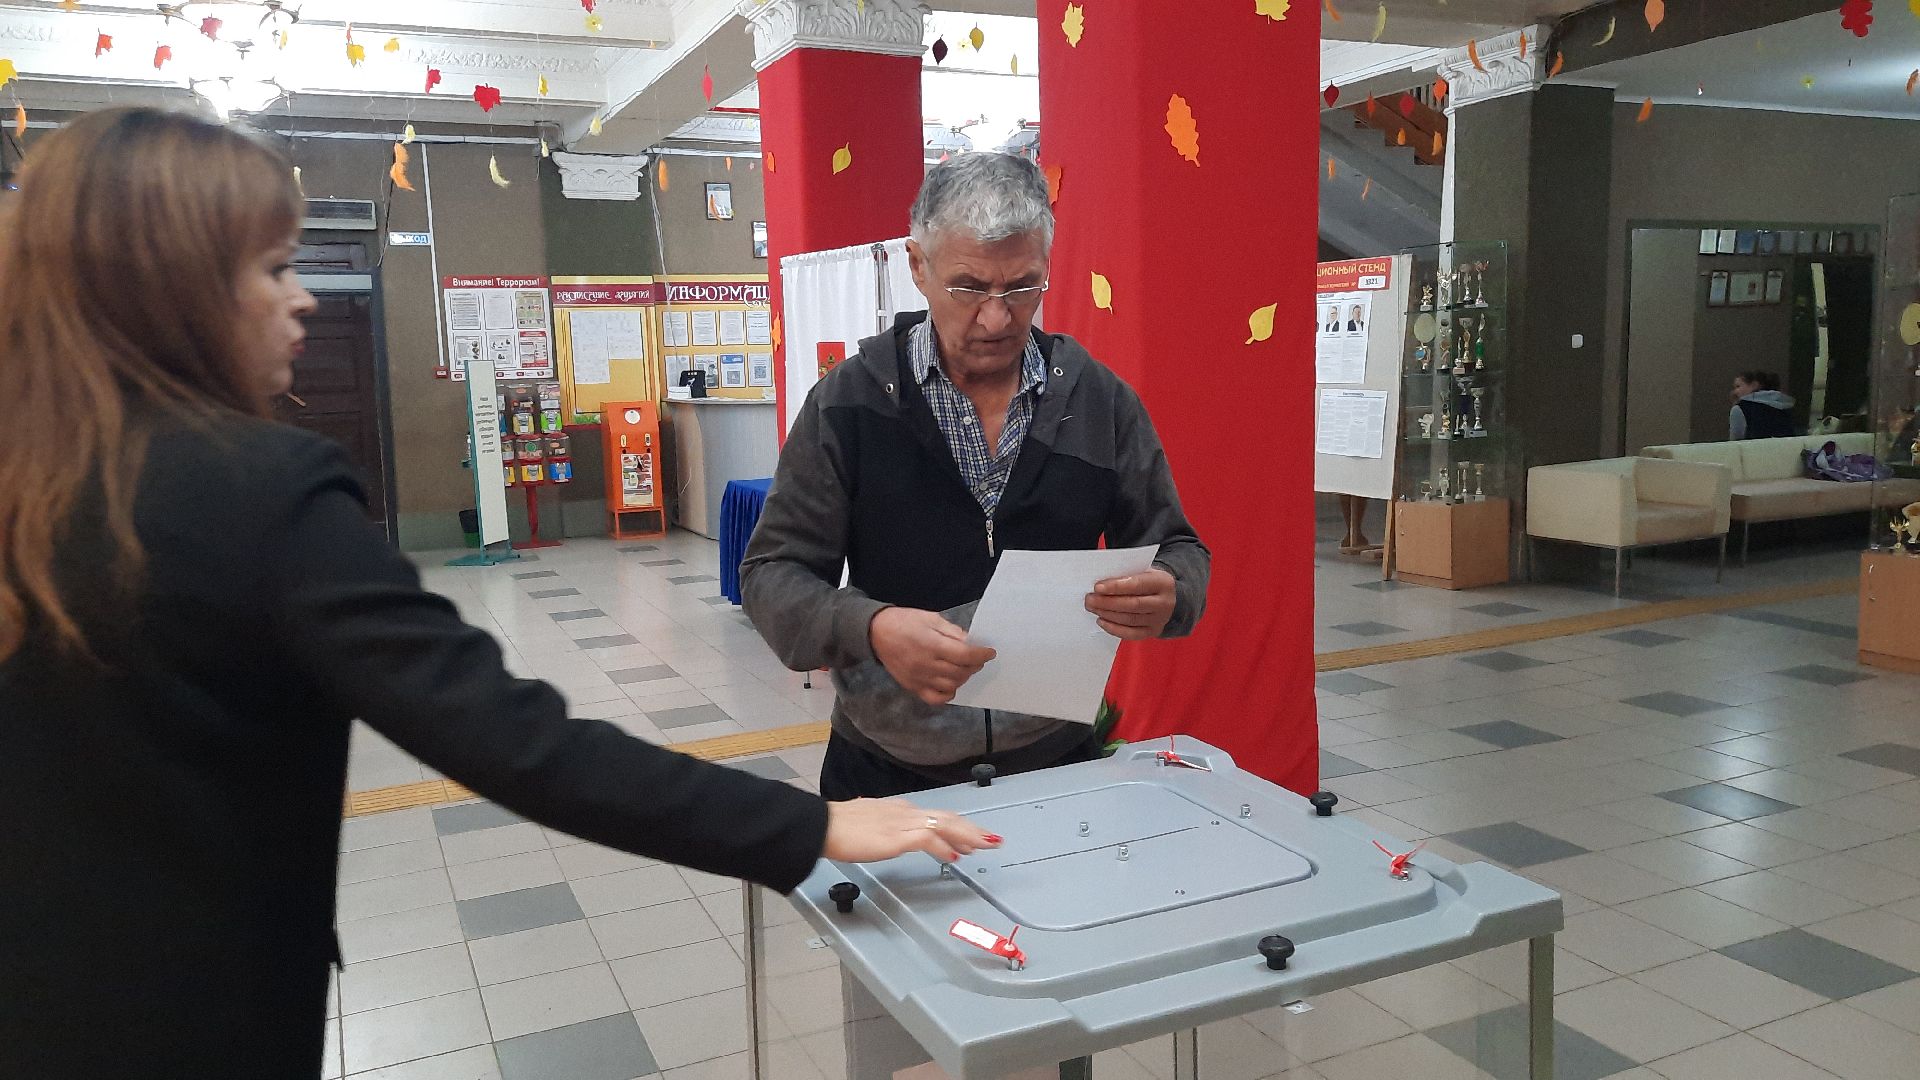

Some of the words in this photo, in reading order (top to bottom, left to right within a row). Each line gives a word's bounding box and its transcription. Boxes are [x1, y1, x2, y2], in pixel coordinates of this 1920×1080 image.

[1358, 262, 1386, 274] СТЕНД
[452, 278, 494, 287] Внимание!
[496, 278, 540, 288] Терроризм!
[667, 285, 770, 308] ИНФОРМАЦ
